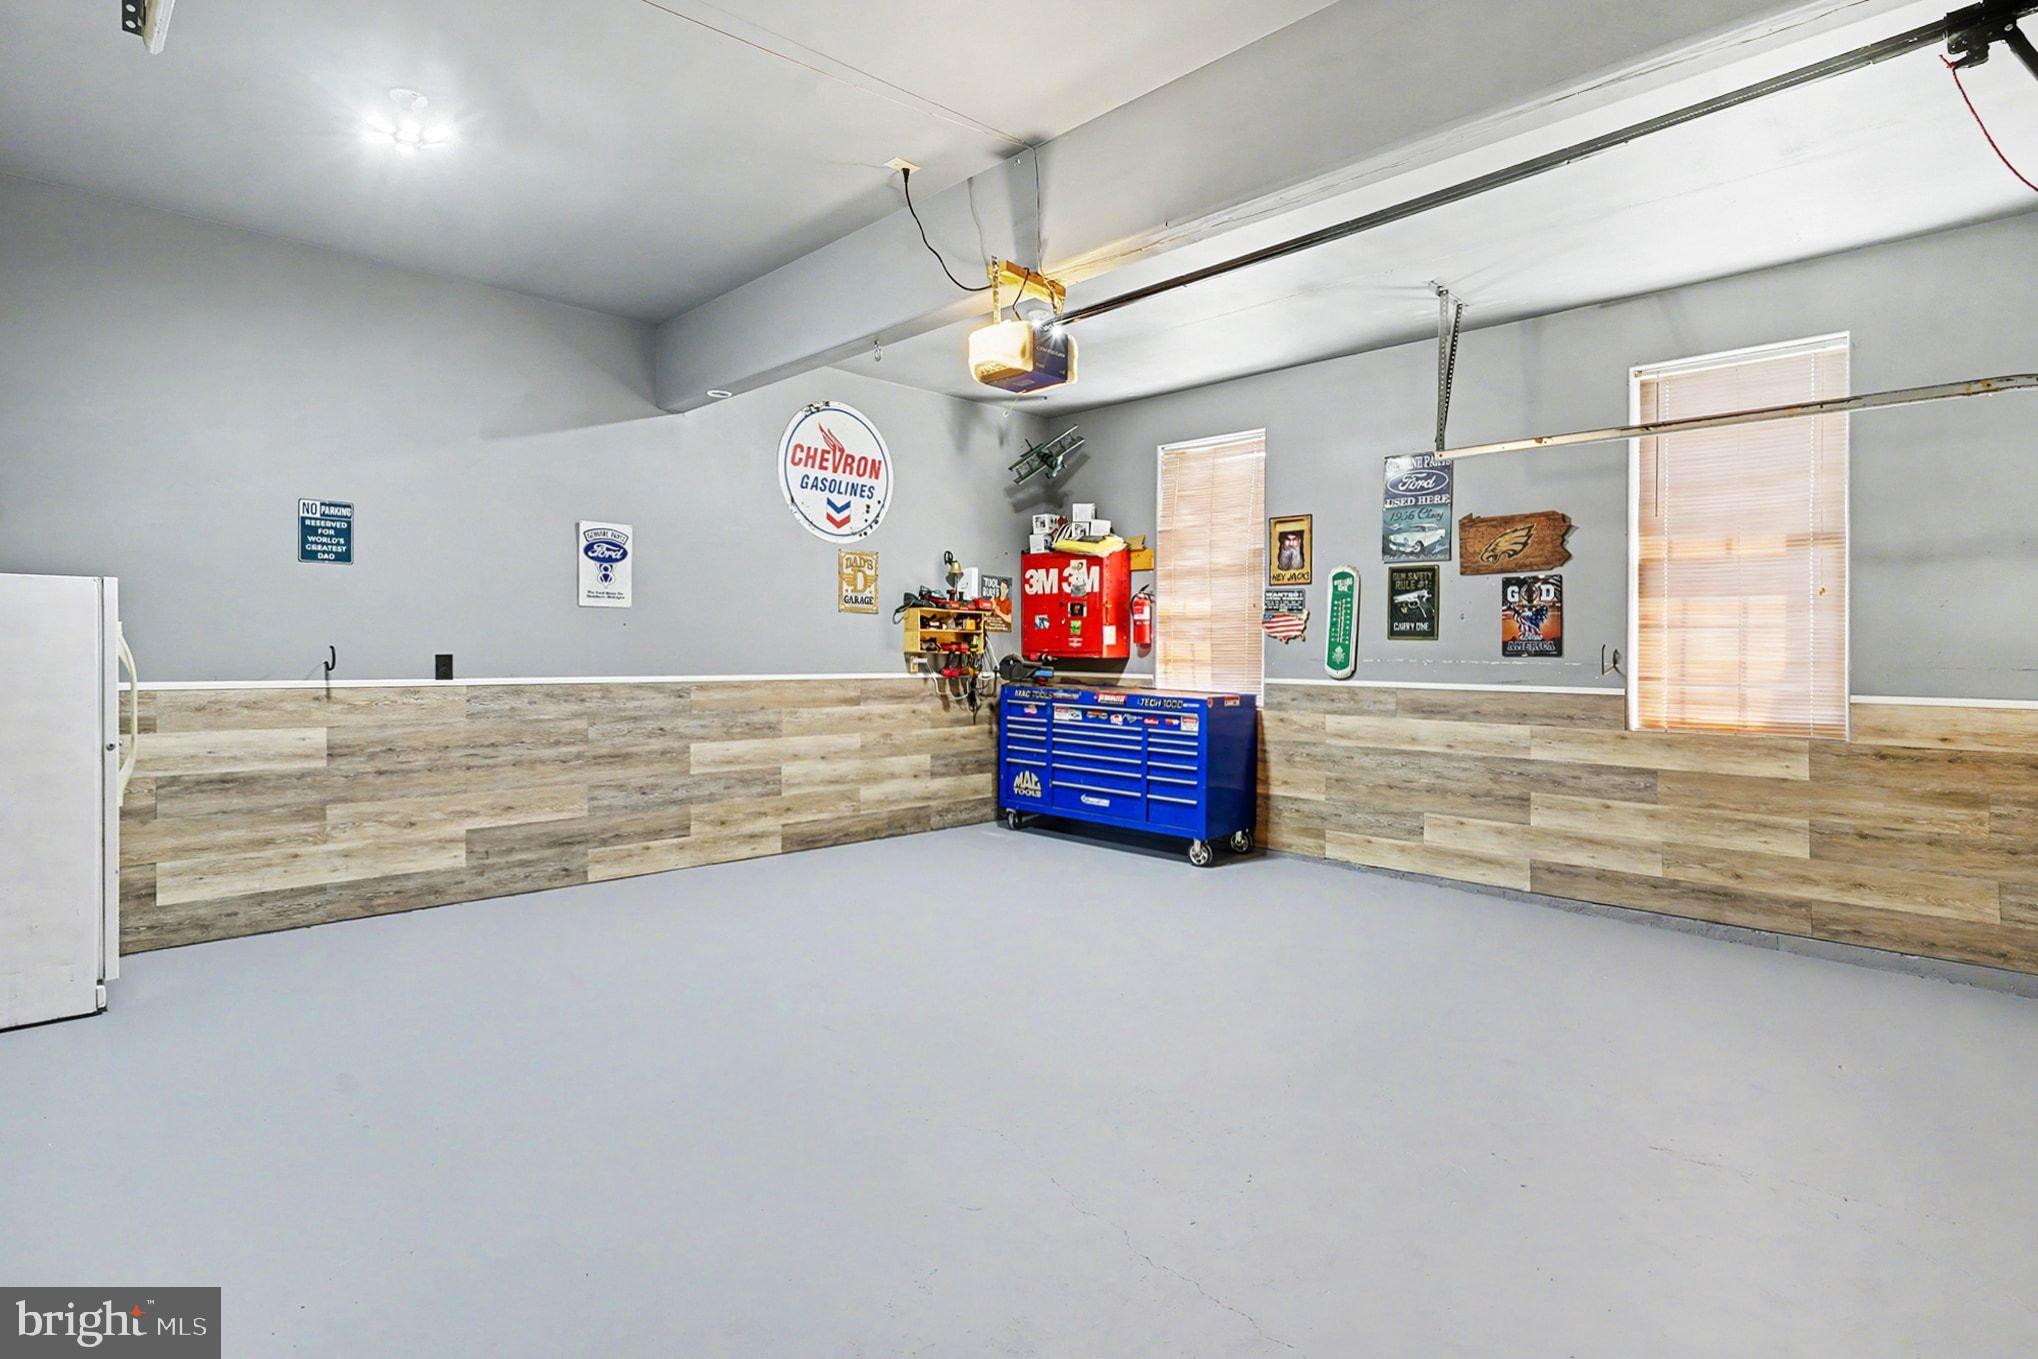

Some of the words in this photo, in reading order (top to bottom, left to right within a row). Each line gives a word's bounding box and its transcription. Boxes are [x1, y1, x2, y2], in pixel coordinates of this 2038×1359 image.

[790, 443, 882, 480] CHEVRON
[800, 474, 875, 499] GASOLINES
[1398, 473, 1436, 490] Ford
[1384, 497, 1415, 507] USED
[1417, 494, 1451, 505] HERE
[302, 502, 318, 515] NO
[320, 505, 352, 517] PARKING
[305, 519, 347, 528] RESERVED
[307, 536, 345, 544] WORLD'S
[305, 544, 347, 552] GREATEST
[588, 543, 624, 559] Ford
[845, 556, 873, 570] DAD'S
[1061, 566, 1100, 593] 3M
[1272, 572, 1286, 581] HEY
[1407, 571, 1432, 580] SAFETY
[1024, 568, 1059, 595] 3M
[1395, 580, 1416, 590] RULE
[844, 595, 874, 605] GARAGE
[1393, 622, 1414, 631] CARRY
[1507, 641, 1555, 650] AMERICA
[1140, 698, 1161, 707] TECH
[1013, 770, 1041, 790] MAC
[1014, 788, 1041, 798] TOOLS
